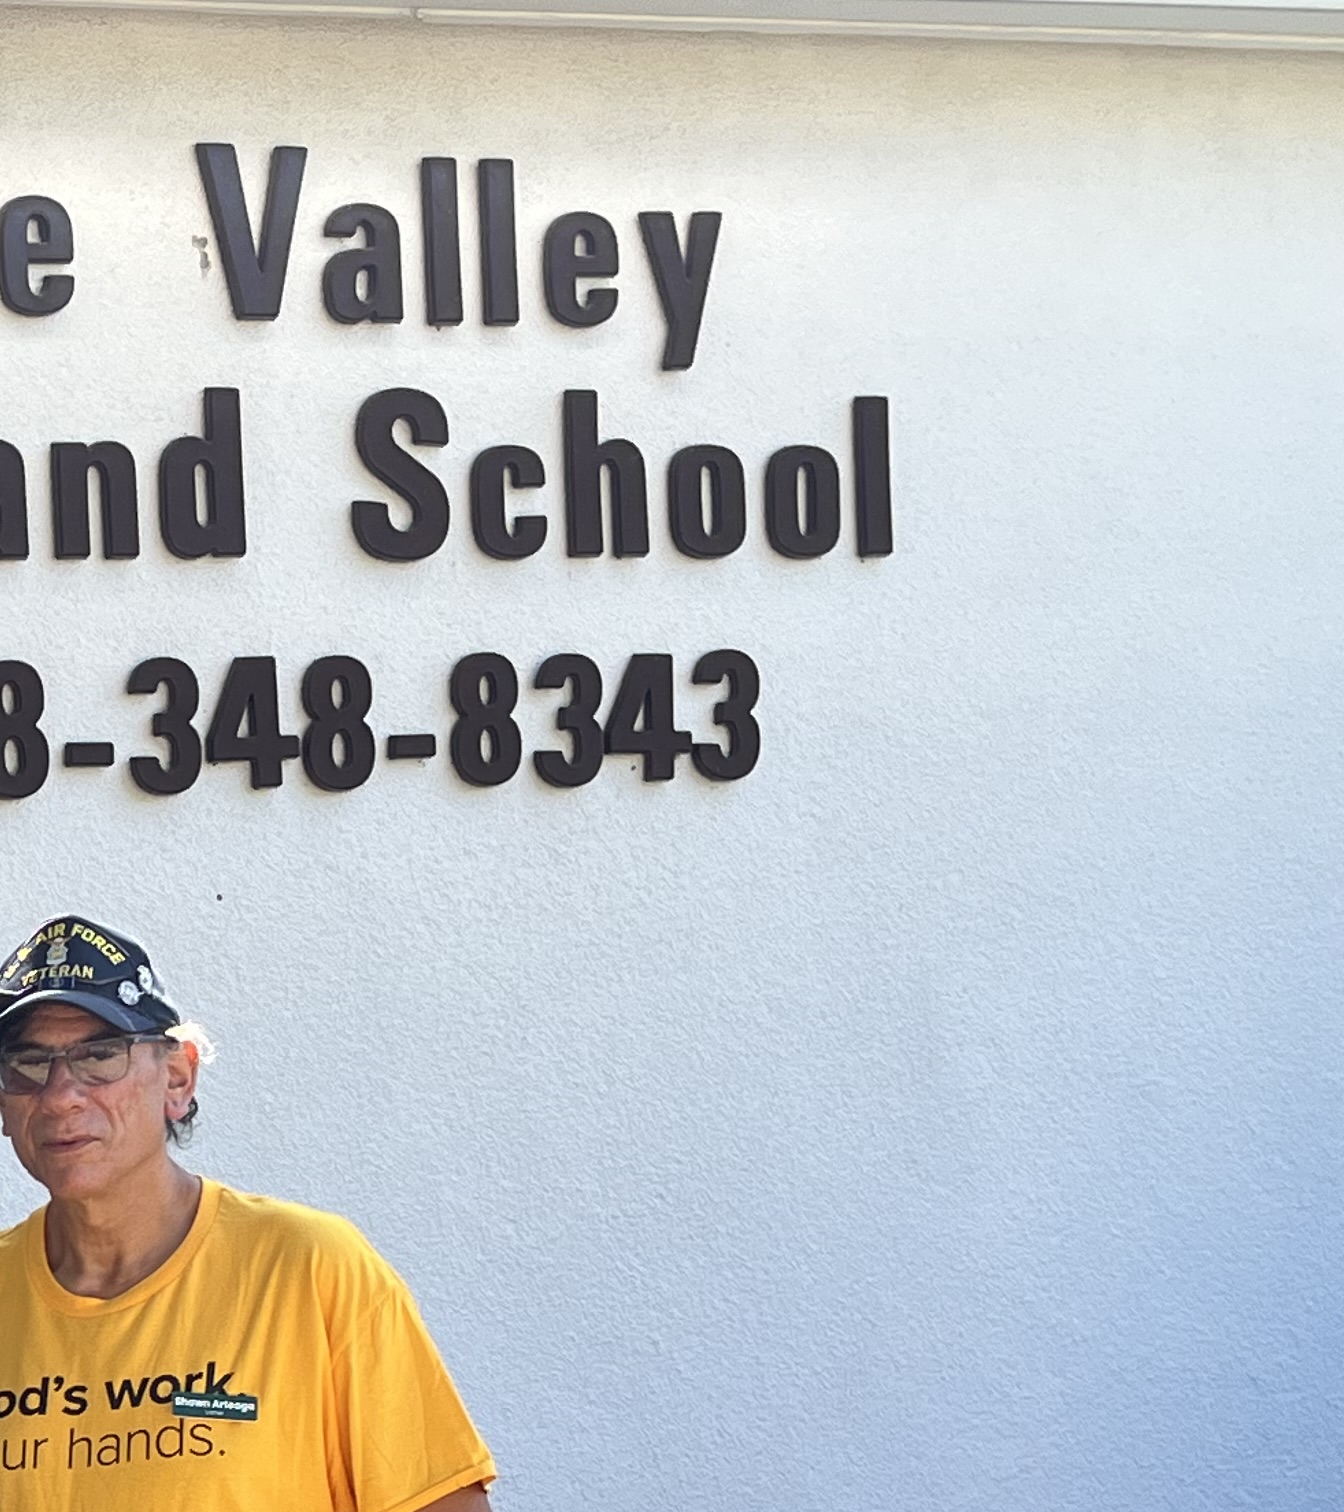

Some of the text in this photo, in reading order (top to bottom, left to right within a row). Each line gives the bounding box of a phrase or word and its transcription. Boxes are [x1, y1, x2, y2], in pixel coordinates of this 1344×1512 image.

[195, 144, 721, 371] Valley
[351, 388, 892, 562] School
[34, 922, 66, 945] AIR
[71, 923, 125, 966] FORCE
[67, 1420, 226, 1470] hands.
